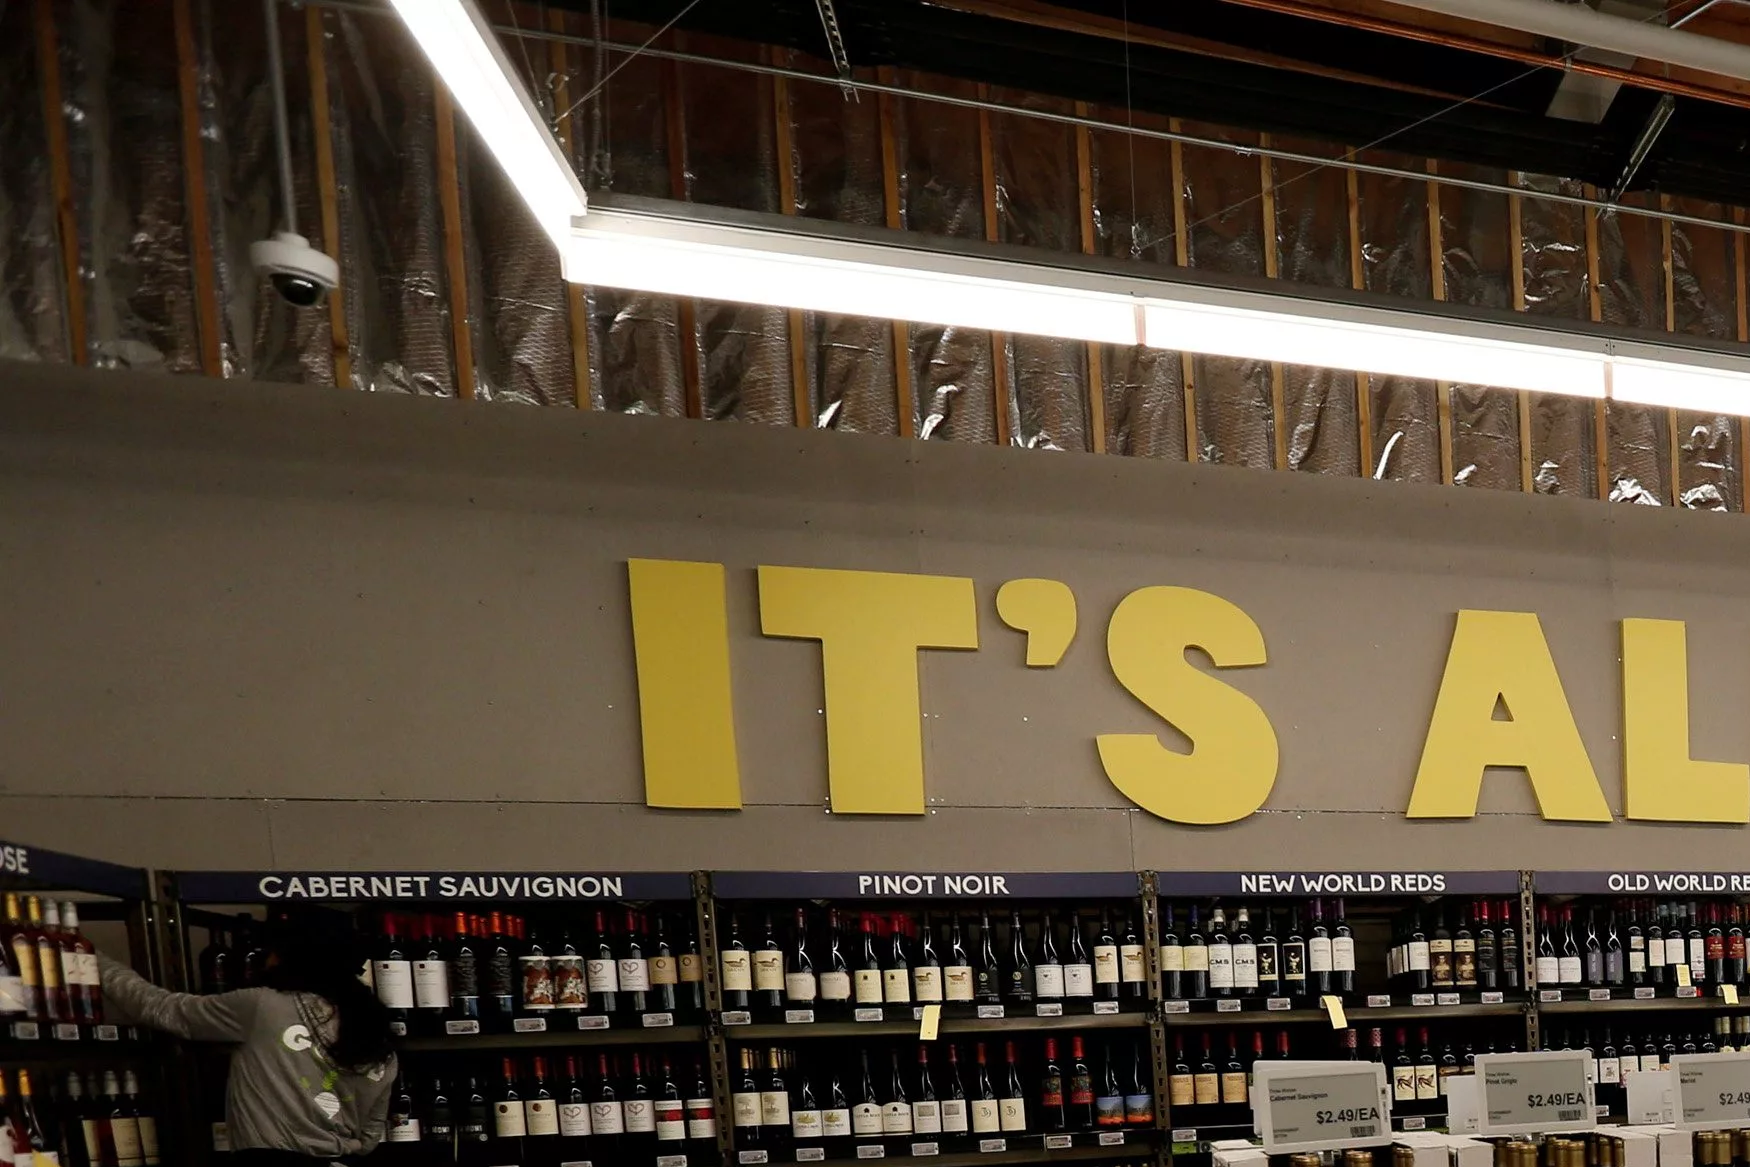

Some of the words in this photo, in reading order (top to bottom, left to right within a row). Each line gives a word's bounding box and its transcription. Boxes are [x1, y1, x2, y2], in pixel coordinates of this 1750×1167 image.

[628, 558, 1278, 823] IT'S
[259, 876, 430, 898] CABERNET
[439, 876, 623, 897] SAUVIGNON
[858, 875, 936, 895] PINOT
[943, 876, 1010, 895] NOIR
[1241, 874, 1295, 892] NEW
[1300, 874, 1386, 892] WORLD
[1391, 874, 1446, 892] REDS
[1608, 873, 1650, 891] OLD
[1653, 874, 1727, 891] WORLD
[1270, 1093, 1296, 1102] Cabernet
[1297, 1091, 1329, 1101] Sauvignon
[1528, 1092, 1585, 1108] $2.49/EA
[1316, 1107, 1379, 1124] $2.49/EA
